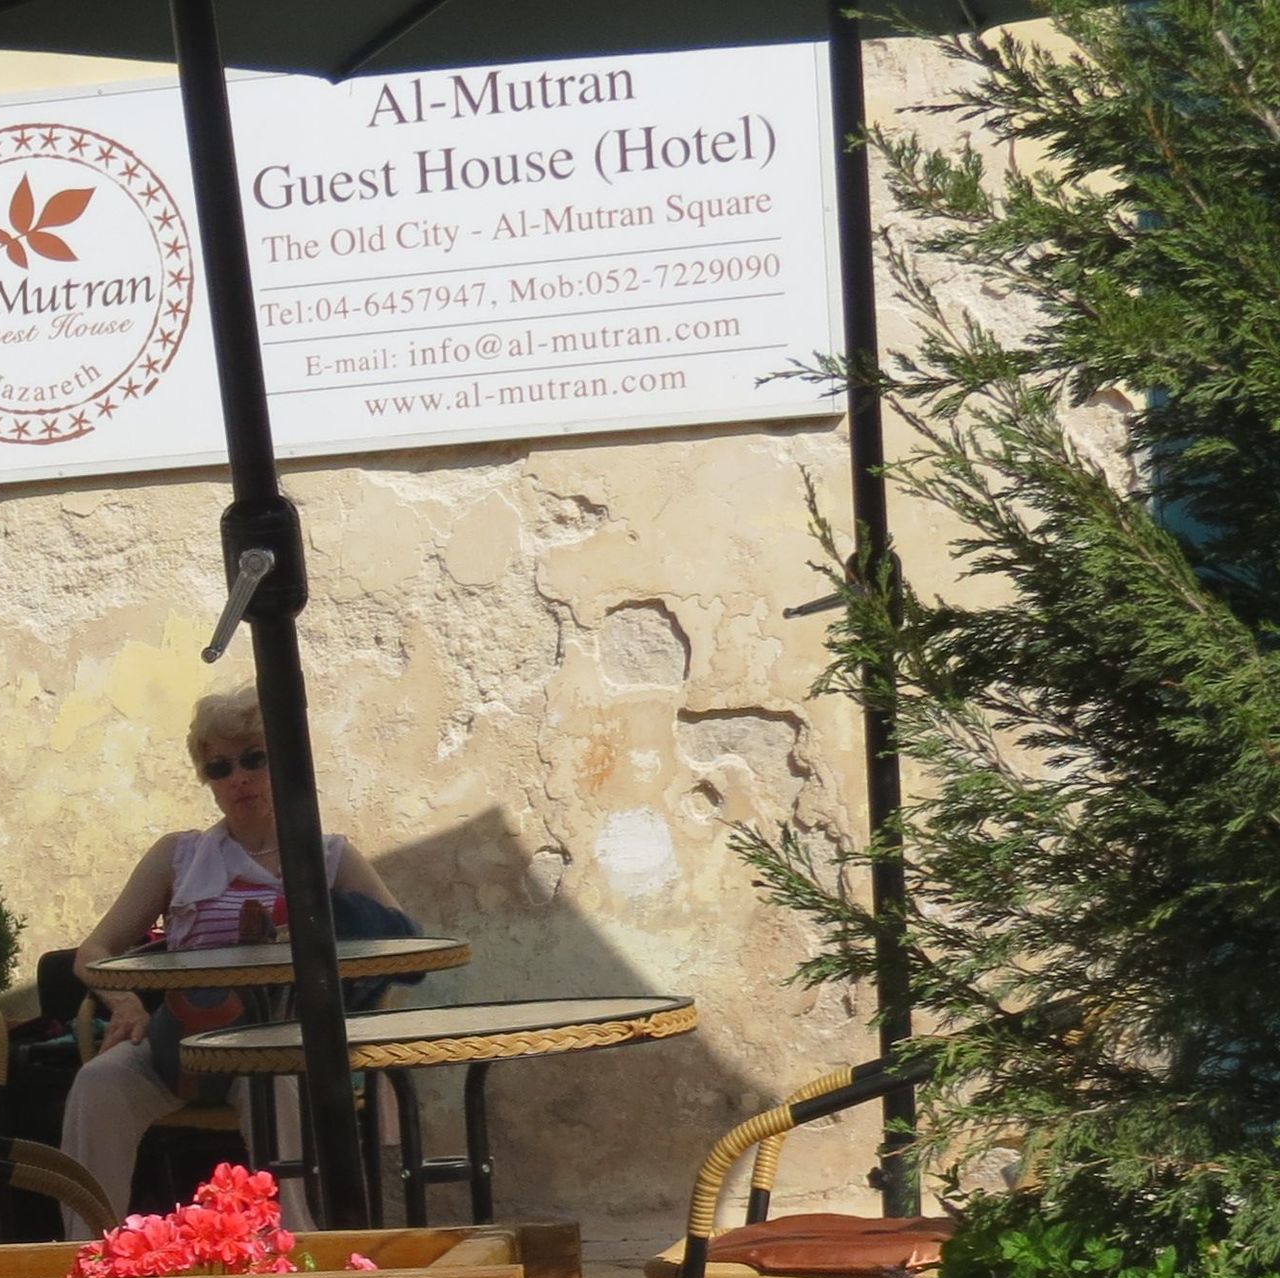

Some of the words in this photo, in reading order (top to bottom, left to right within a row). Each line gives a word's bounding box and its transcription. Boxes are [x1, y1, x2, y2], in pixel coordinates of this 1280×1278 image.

[366, 68, 635, 128] Al-Mutran
[253, 160, 399, 210] Guest
[414, 146, 575, 195] House
[595, 114, 776, 185] (Hotel)
[263, 234, 320, 262] The
[330, 224, 386, 256] Old
[395, 219, 460, 254] City
[492, 204, 655, 242] Al-Mutran
[665, 192, 774, 230] Square
[260, 281, 498, 328] Tel:04-6457947,
[509, 253, 782, 304] Mob:052-7229090
[48, 311, 136, 341] House
[305, 346, 399, 377] E-mail:
[410, 317, 741, 367] info@al-mutran.com
[365, 370, 687, 416] www.al-mutran.com
